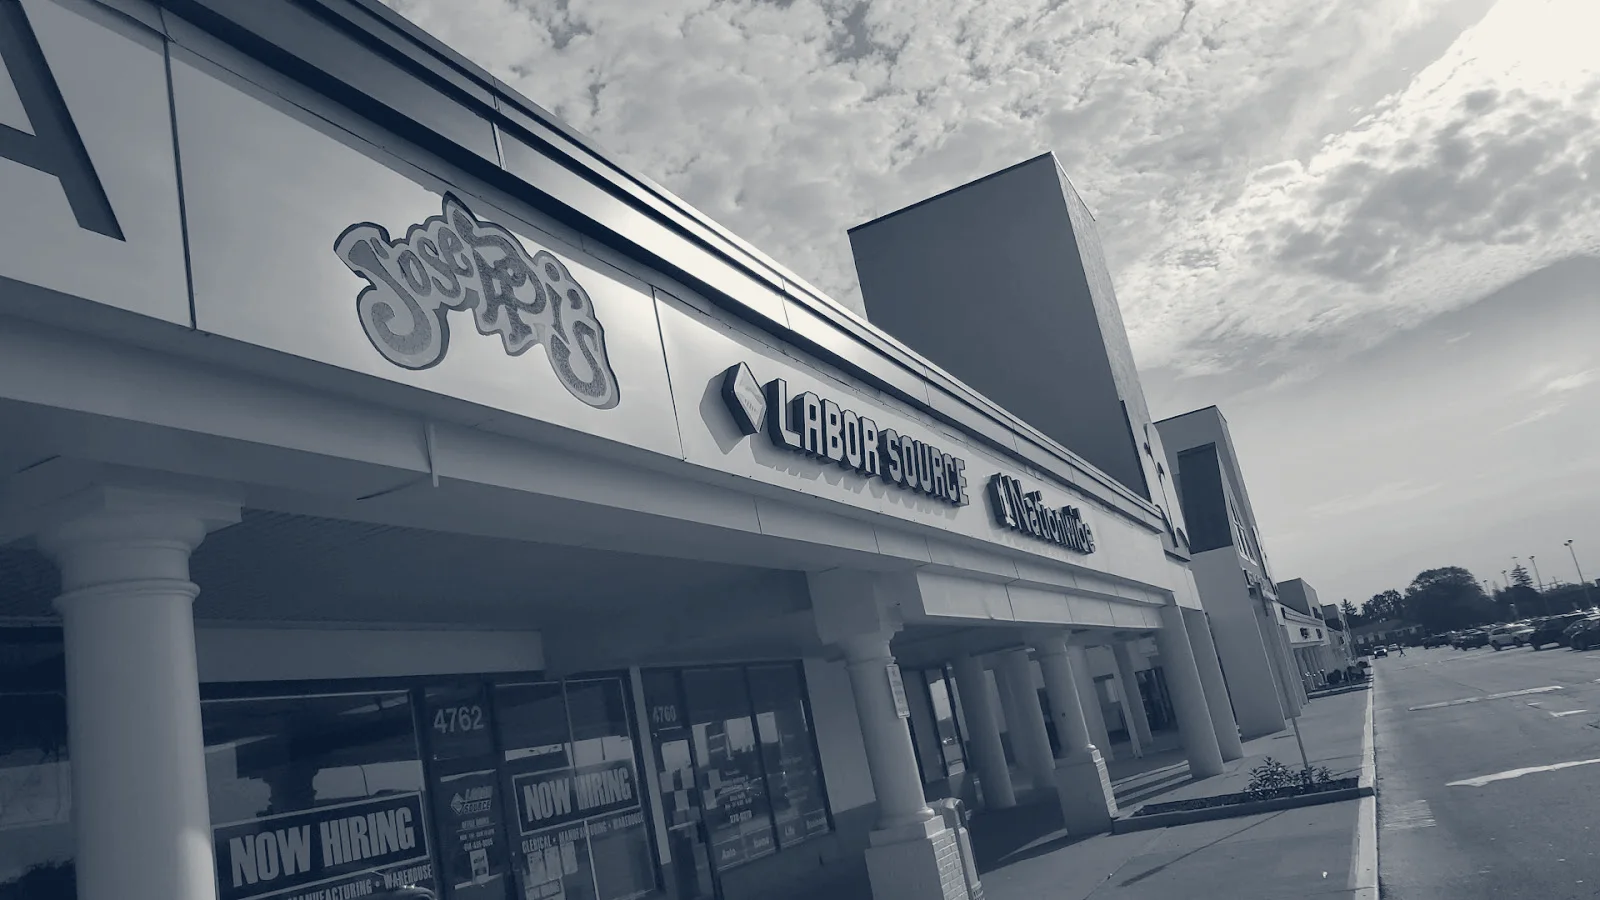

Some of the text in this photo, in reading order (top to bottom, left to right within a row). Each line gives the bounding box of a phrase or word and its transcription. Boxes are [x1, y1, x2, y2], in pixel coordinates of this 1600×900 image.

[769, 378, 969, 507] LABOR SOURCE
[1003, 475, 1096, 554] Nationwide
[434, 705, 484, 734] 4762
[523, 767, 632, 822] NOW HIRING
[229, 806, 416, 888] NOW HIRING
[559, 821, 608, 843] MANUFATURING
[288, 864, 432, 900] UFACTURING WAREHOUSE
